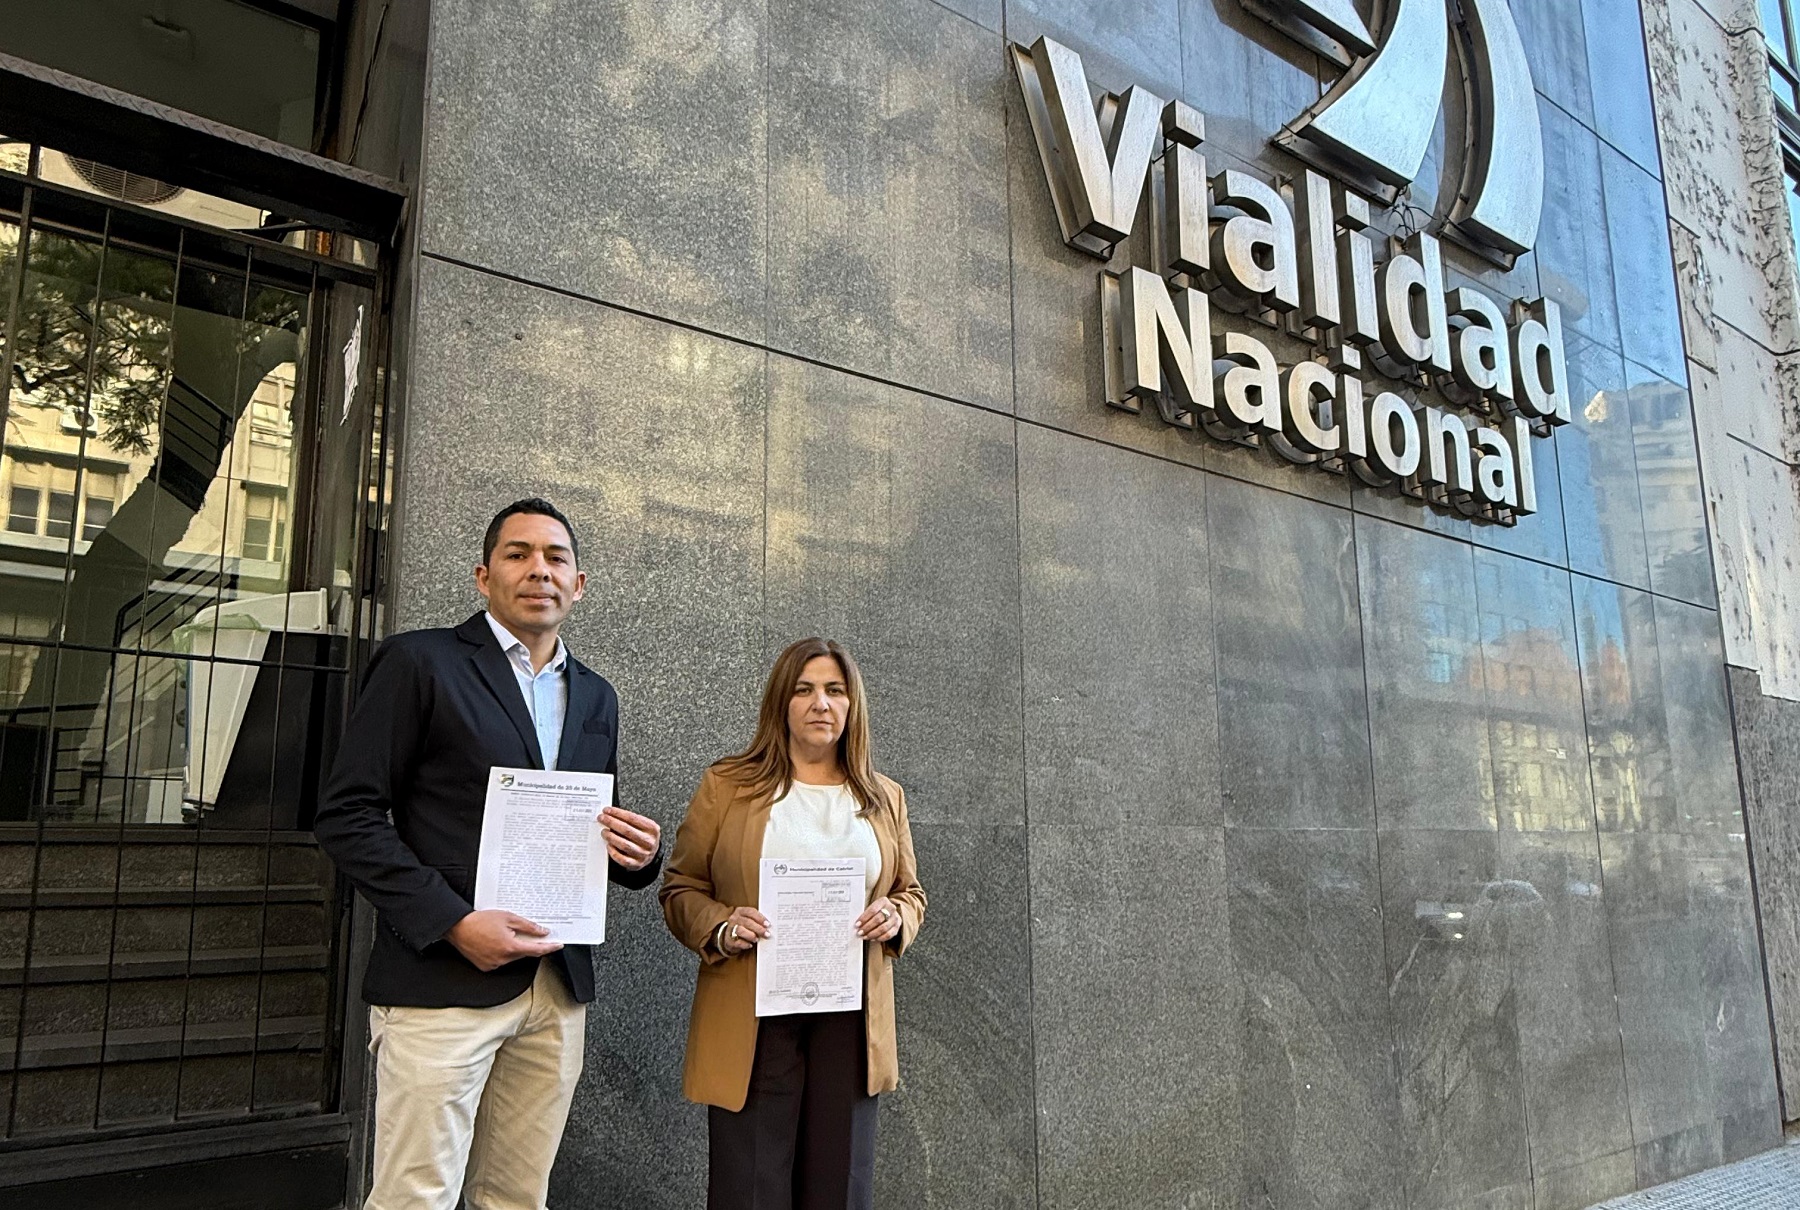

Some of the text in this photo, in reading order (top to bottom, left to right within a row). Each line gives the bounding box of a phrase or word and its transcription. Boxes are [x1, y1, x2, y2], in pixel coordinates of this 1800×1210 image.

[1026, 35, 1571, 427] Vialidad
[1118, 266, 1537, 516] Nacional
[517, 781, 556, 789] Municipalidad
